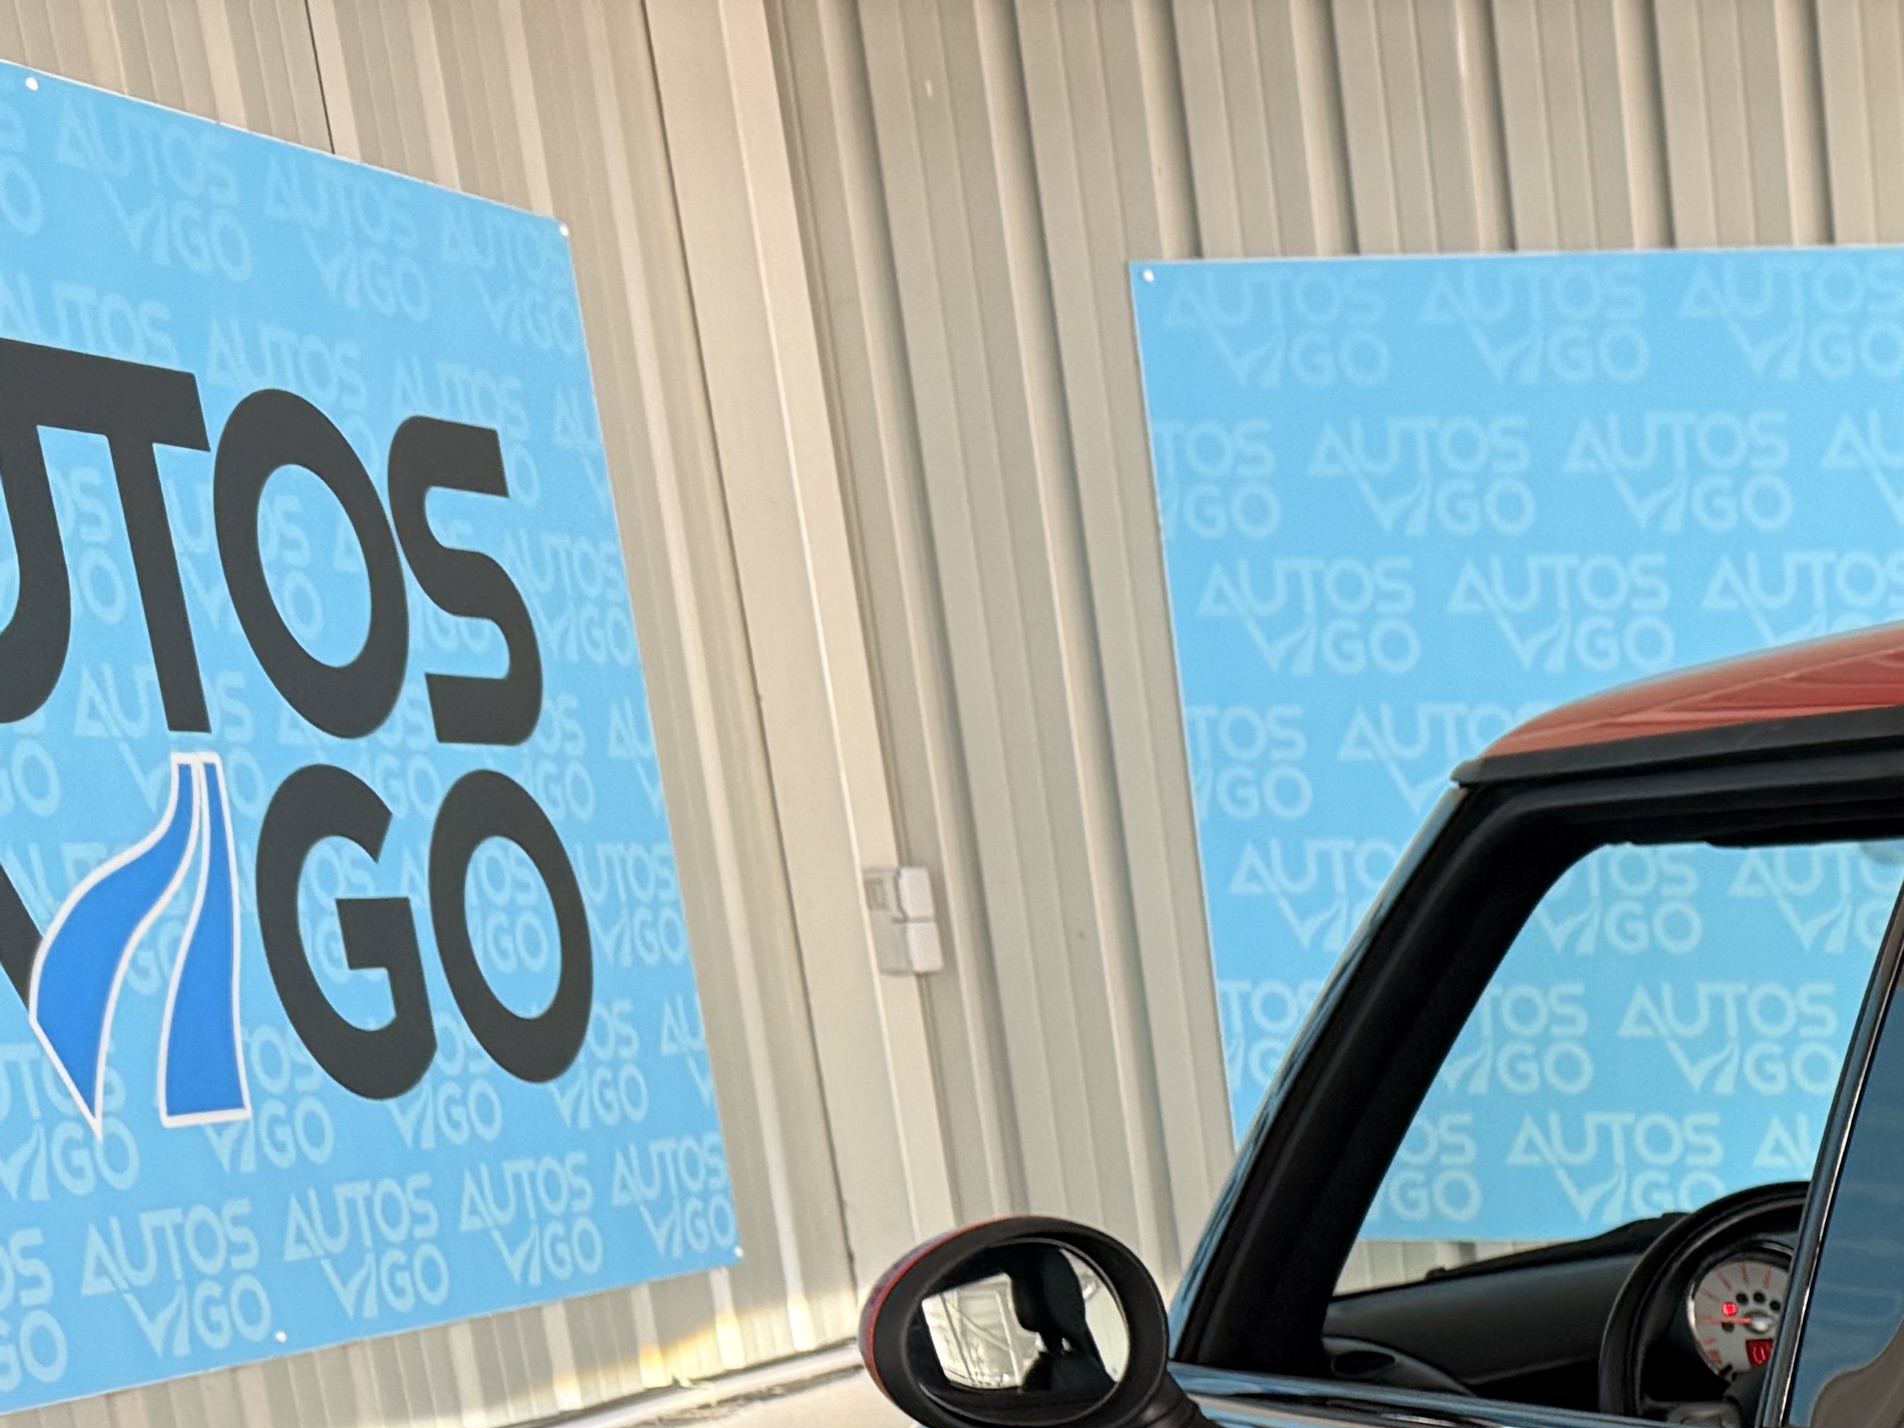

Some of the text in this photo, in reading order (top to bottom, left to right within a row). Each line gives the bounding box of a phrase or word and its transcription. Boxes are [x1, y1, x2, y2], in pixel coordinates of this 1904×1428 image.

[1161, 264, 1387, 328] AUTOS
[1415, 261, 1648, 326] AUTOS
[1207, 326, 1391, 390] VIGO
[1463, 322, 1651, 386] VIGO
[1153, 419, 1275, 479] TOS
[1307, 413, 1534, 478] AUTOS
[1563, 410, 1792, 475] AUTOS
[1354, 472, 1536, 535] VIGO
[1608, 469, 1794, 533] VIGO
[1196, 555, 1416, 617] AUTOS
[1448, 553, 1673, 612] AUTOS
[1242, 611, 1420, 676] VIGO
[1496, 610, 1675, 673] VIGO
[1187, 706, 1307, 763] TOS
[1617, 980, 1838, 1040] AUTOS
[1667, 1036, 1838, 1096] VIGO
[610, 1131, 727, 1207] AUTOS
[1506, 1111, 1722, 1168] AUTOS
[283, 1173, 439, 1262] AUTOS
[460, 1154, 593, 1231] AUTOS
[81, 1200, 259, 1297] AUTOS
[493, 1218, 602, 1285] VIGO
[640, 1197, 737, 1259] VIGO
[319, 1245, 450, 1319] VIGO
[123, 1281, 272, 1357] VIGO
